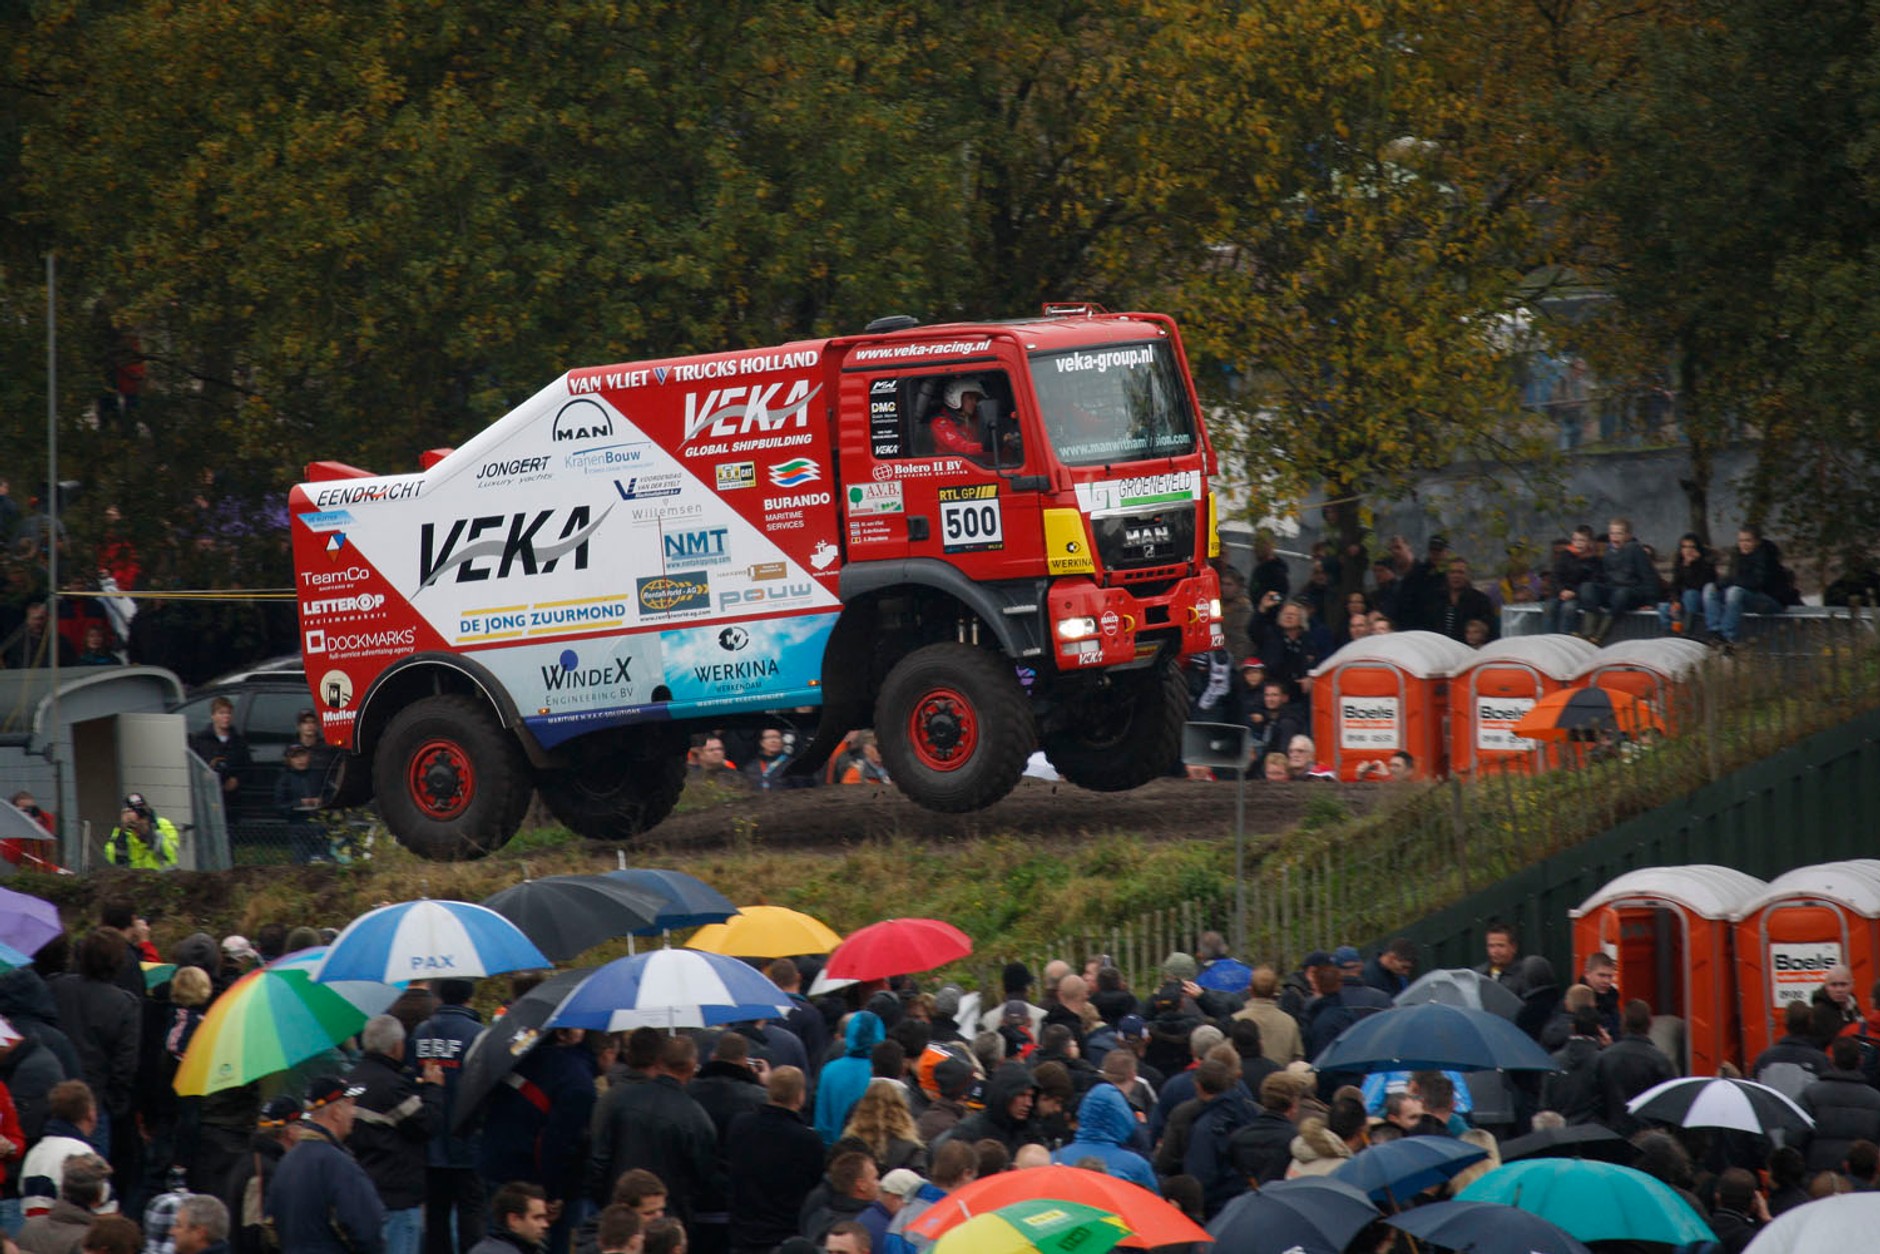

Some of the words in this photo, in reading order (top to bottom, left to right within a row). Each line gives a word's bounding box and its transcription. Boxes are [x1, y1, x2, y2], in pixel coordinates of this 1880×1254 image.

[856, 340, 992, 360] www.veka-racing.nl
[1056, 344, 1154, 372] veka-group.nl
[569, 376, 602, 395] VAN
[606, 370, 650, 390] VLIET
[674, 360, 737, 382] TRUCKS
[740, 350, 818, 375] HOLLAND
[684, 379, 810, 440] VEKA
[557, 425, 608, 441] MAN
[685, 442, 729, 458] GLOBAL
[732, 434, 812, 452] SHIPBUILDING
[476, 455, 552, 480] JONGERT
[565, 450, 641, 470] KranenBouw
[894, 463, 931, 474] Bolero
[946, 460, 963, 471] BV
[317, 480, 426, 507] EENDRACHT
[939, 489, 960, 501] RTL
[961, 488, 976, 500] GP
[1119, 471, 1192, 498] GROENEVELD
[764, 492, 831, 511] BURANDO
[765, 511, 804, 522] MARITIME
[766, 520, 805, 531] SERVICES
[946, 505, 997, 540] 500
[664, 528, 728, 557] NMT
[1125, 526, 1169, 541] MAN
[420, 505, 591, 587] VEKA
[1051, 559, 1093, 568] WERKINA
[301, 567, 370, 586] TeamCo
[303, 593, 385, 616] LETTEROP
[460, 618, 480, 633] DE
[484, 613, 526, 634] JONG
[530, 604, 626, 627] ZUURMOND
[327, 629, 415, 651] DOCKMARKS
[329, 651, 361, 660] full-service
[361, 648, 393, 657] advertising
[394, 645, 415, 655] agency
[694, 659, 780, 682] WERKINA
[620, 687, 633, 698] BV
[323, 709, 357, 722] Muller
[1343, 705, 1395, 719] Boels
[411, 955, 455, 970] PAX
[1774, 953, 1836, 970] Boels
